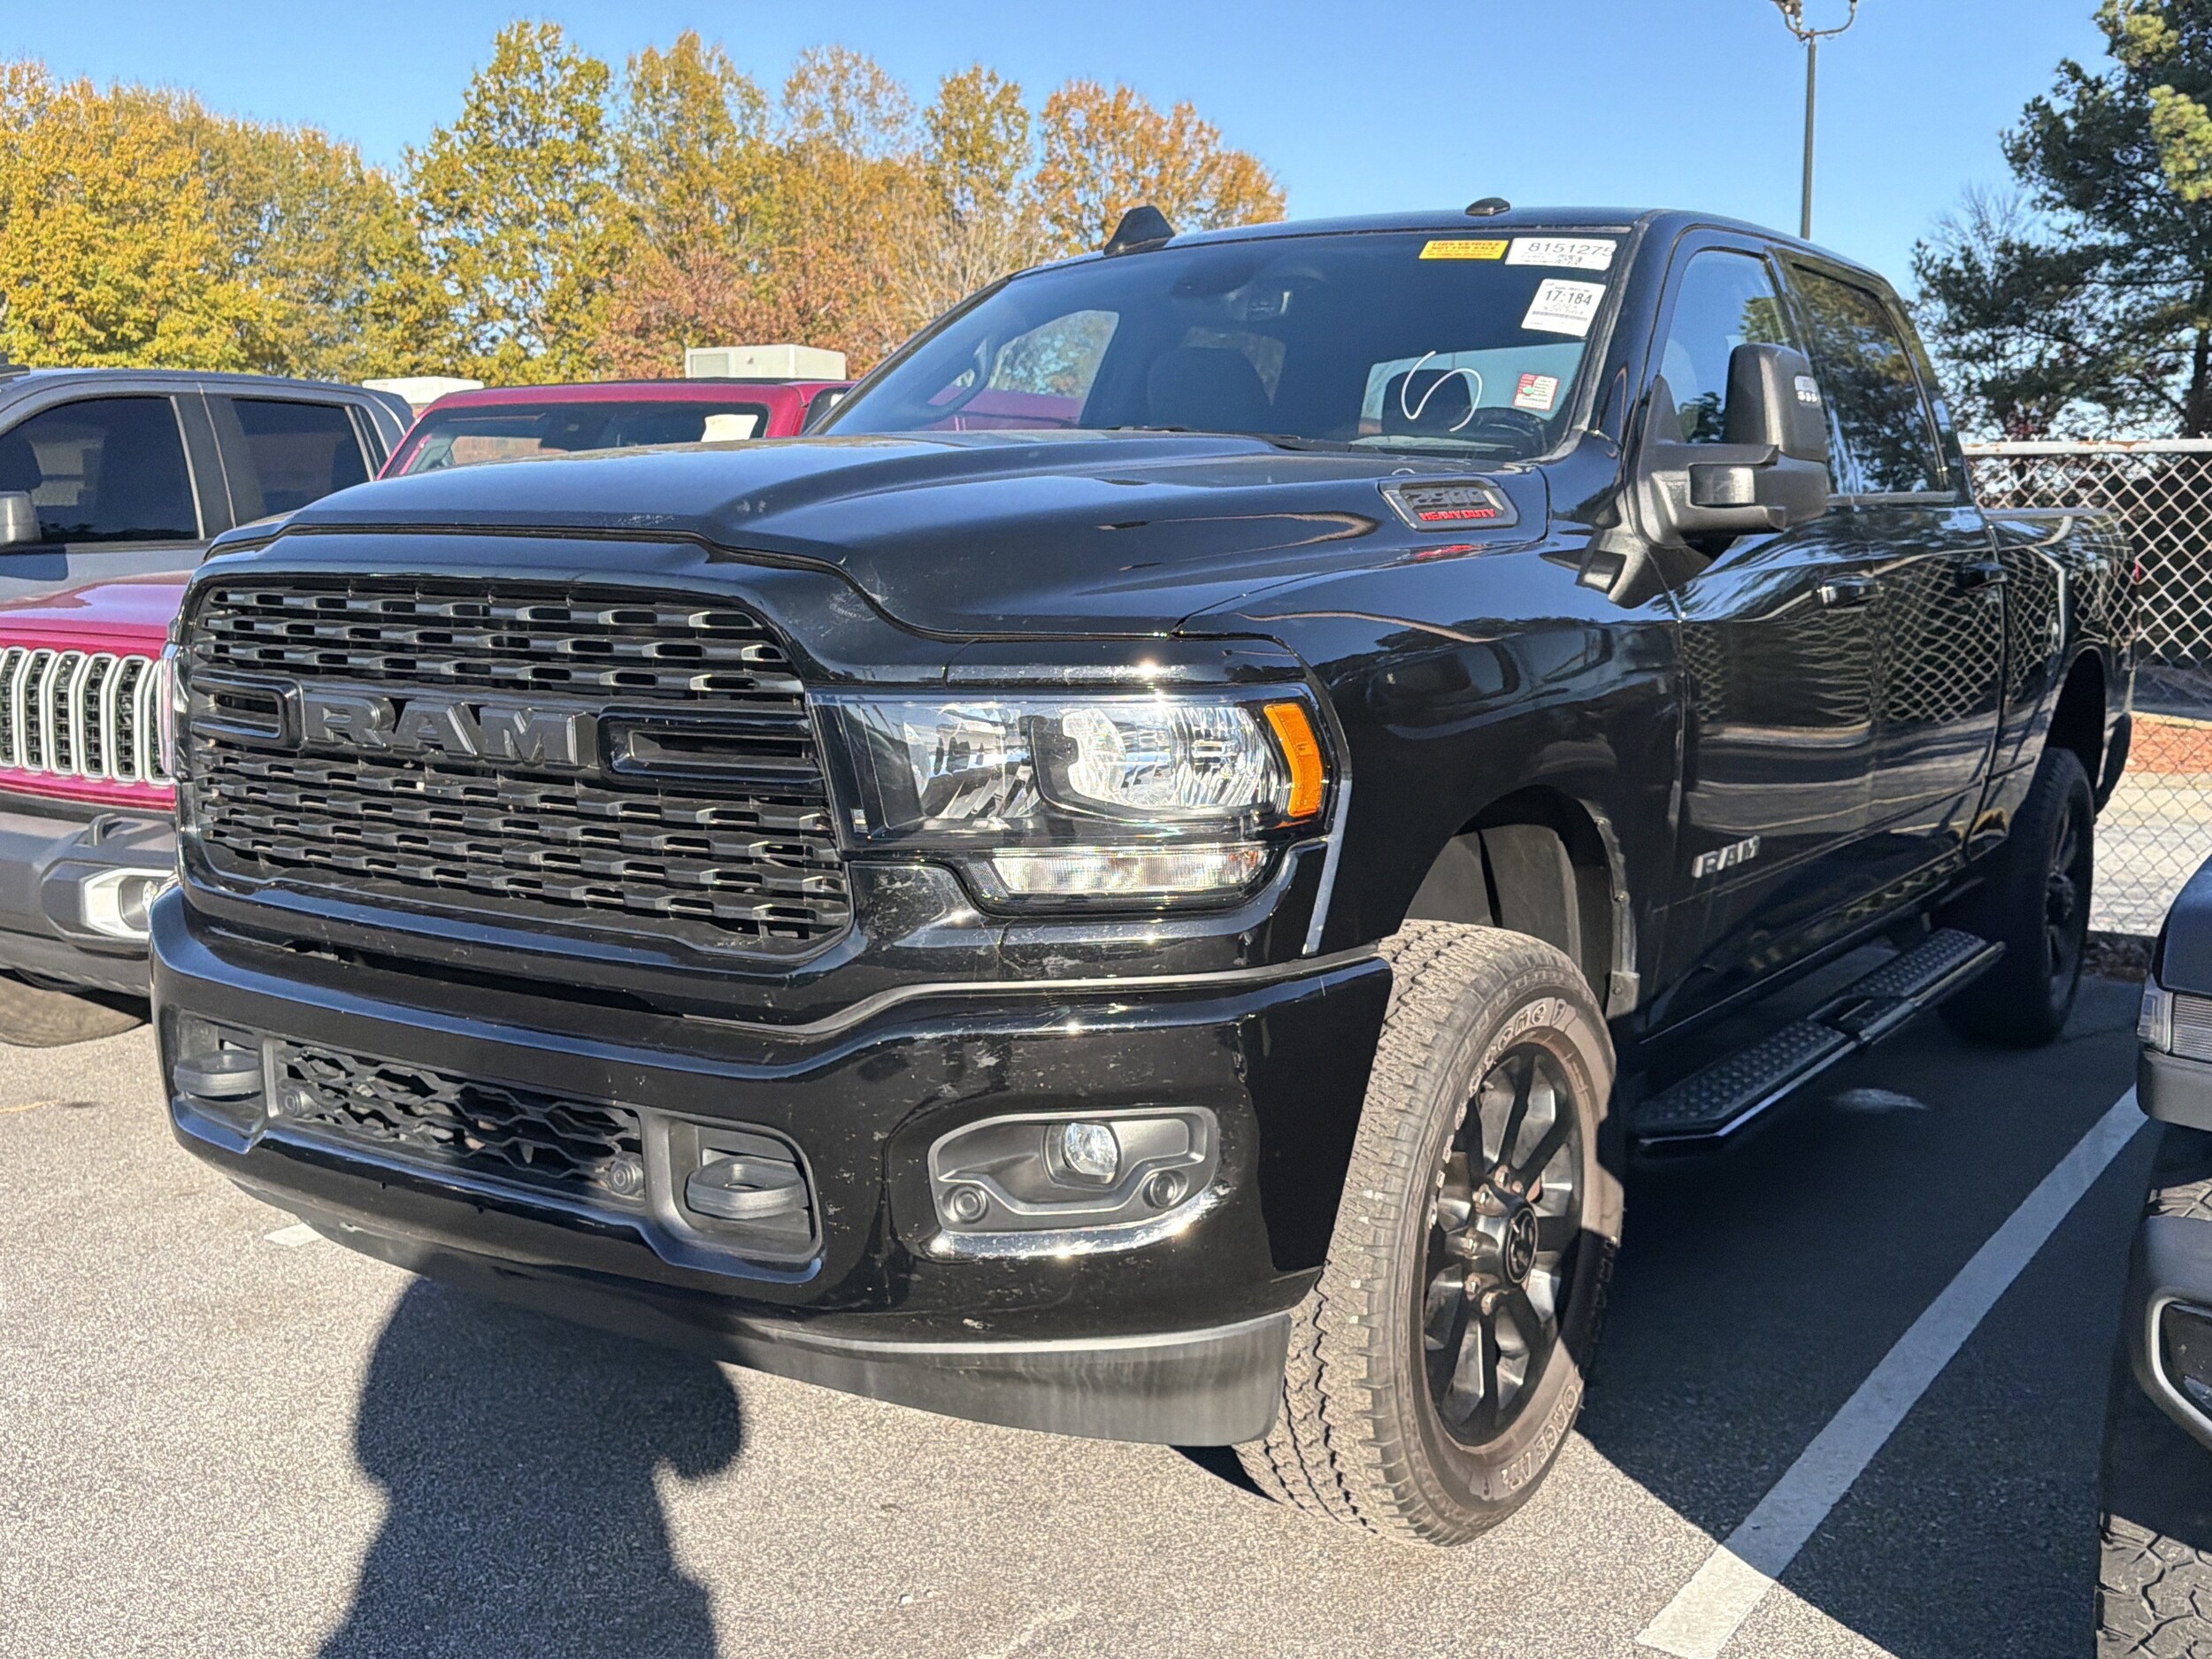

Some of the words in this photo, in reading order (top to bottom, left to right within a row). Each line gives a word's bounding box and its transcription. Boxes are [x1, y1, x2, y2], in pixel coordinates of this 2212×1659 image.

[1418, 511, 1462, 522] HEAVY
[1461, 509, 1496, 520] DUTY
[303, 695, 599, 772] RAM
[1691, 834, 1761, 879] RAM
